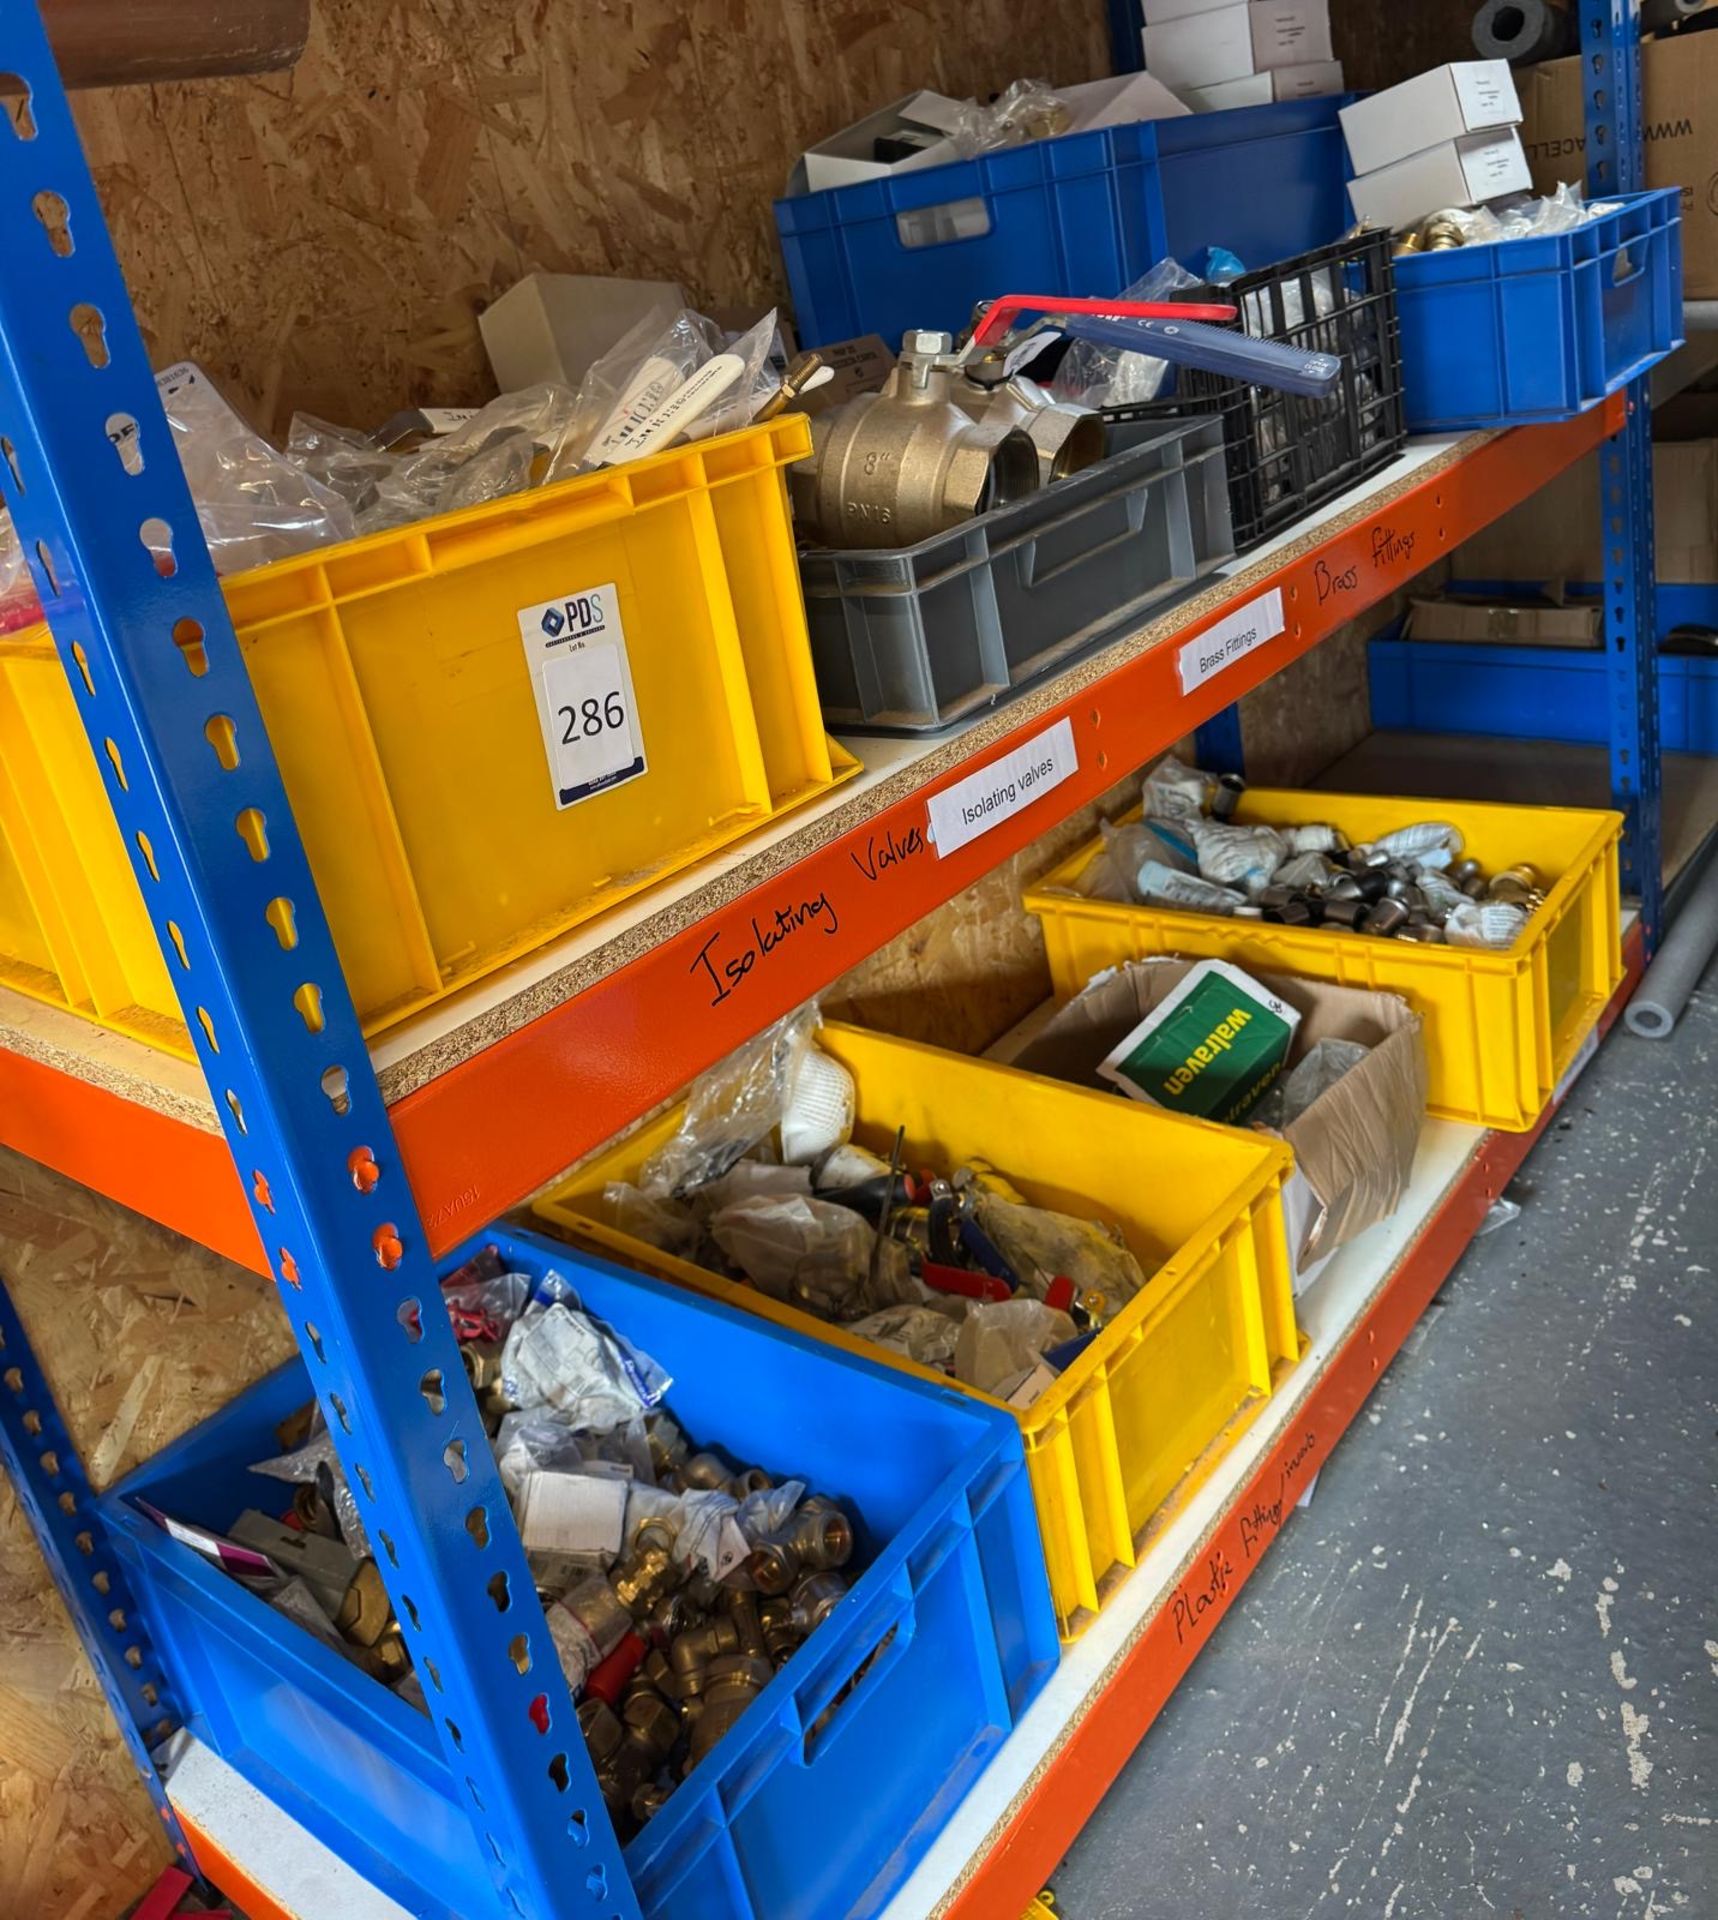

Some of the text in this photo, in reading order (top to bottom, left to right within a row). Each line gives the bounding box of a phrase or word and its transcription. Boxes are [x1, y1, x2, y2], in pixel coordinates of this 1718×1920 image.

[1314, 559, 1358, 605] Brass
[565, 594, 604, 632] PDS
[1199, 627, 1257, 673] Brass Fittings
[558, 691, 624, 745] 286
[961, 757, 1054, 825] Isolating valves
[689, 824, 924, 1007] Isolating Valves
[1163, 1008, 1252, 1095] walraven
